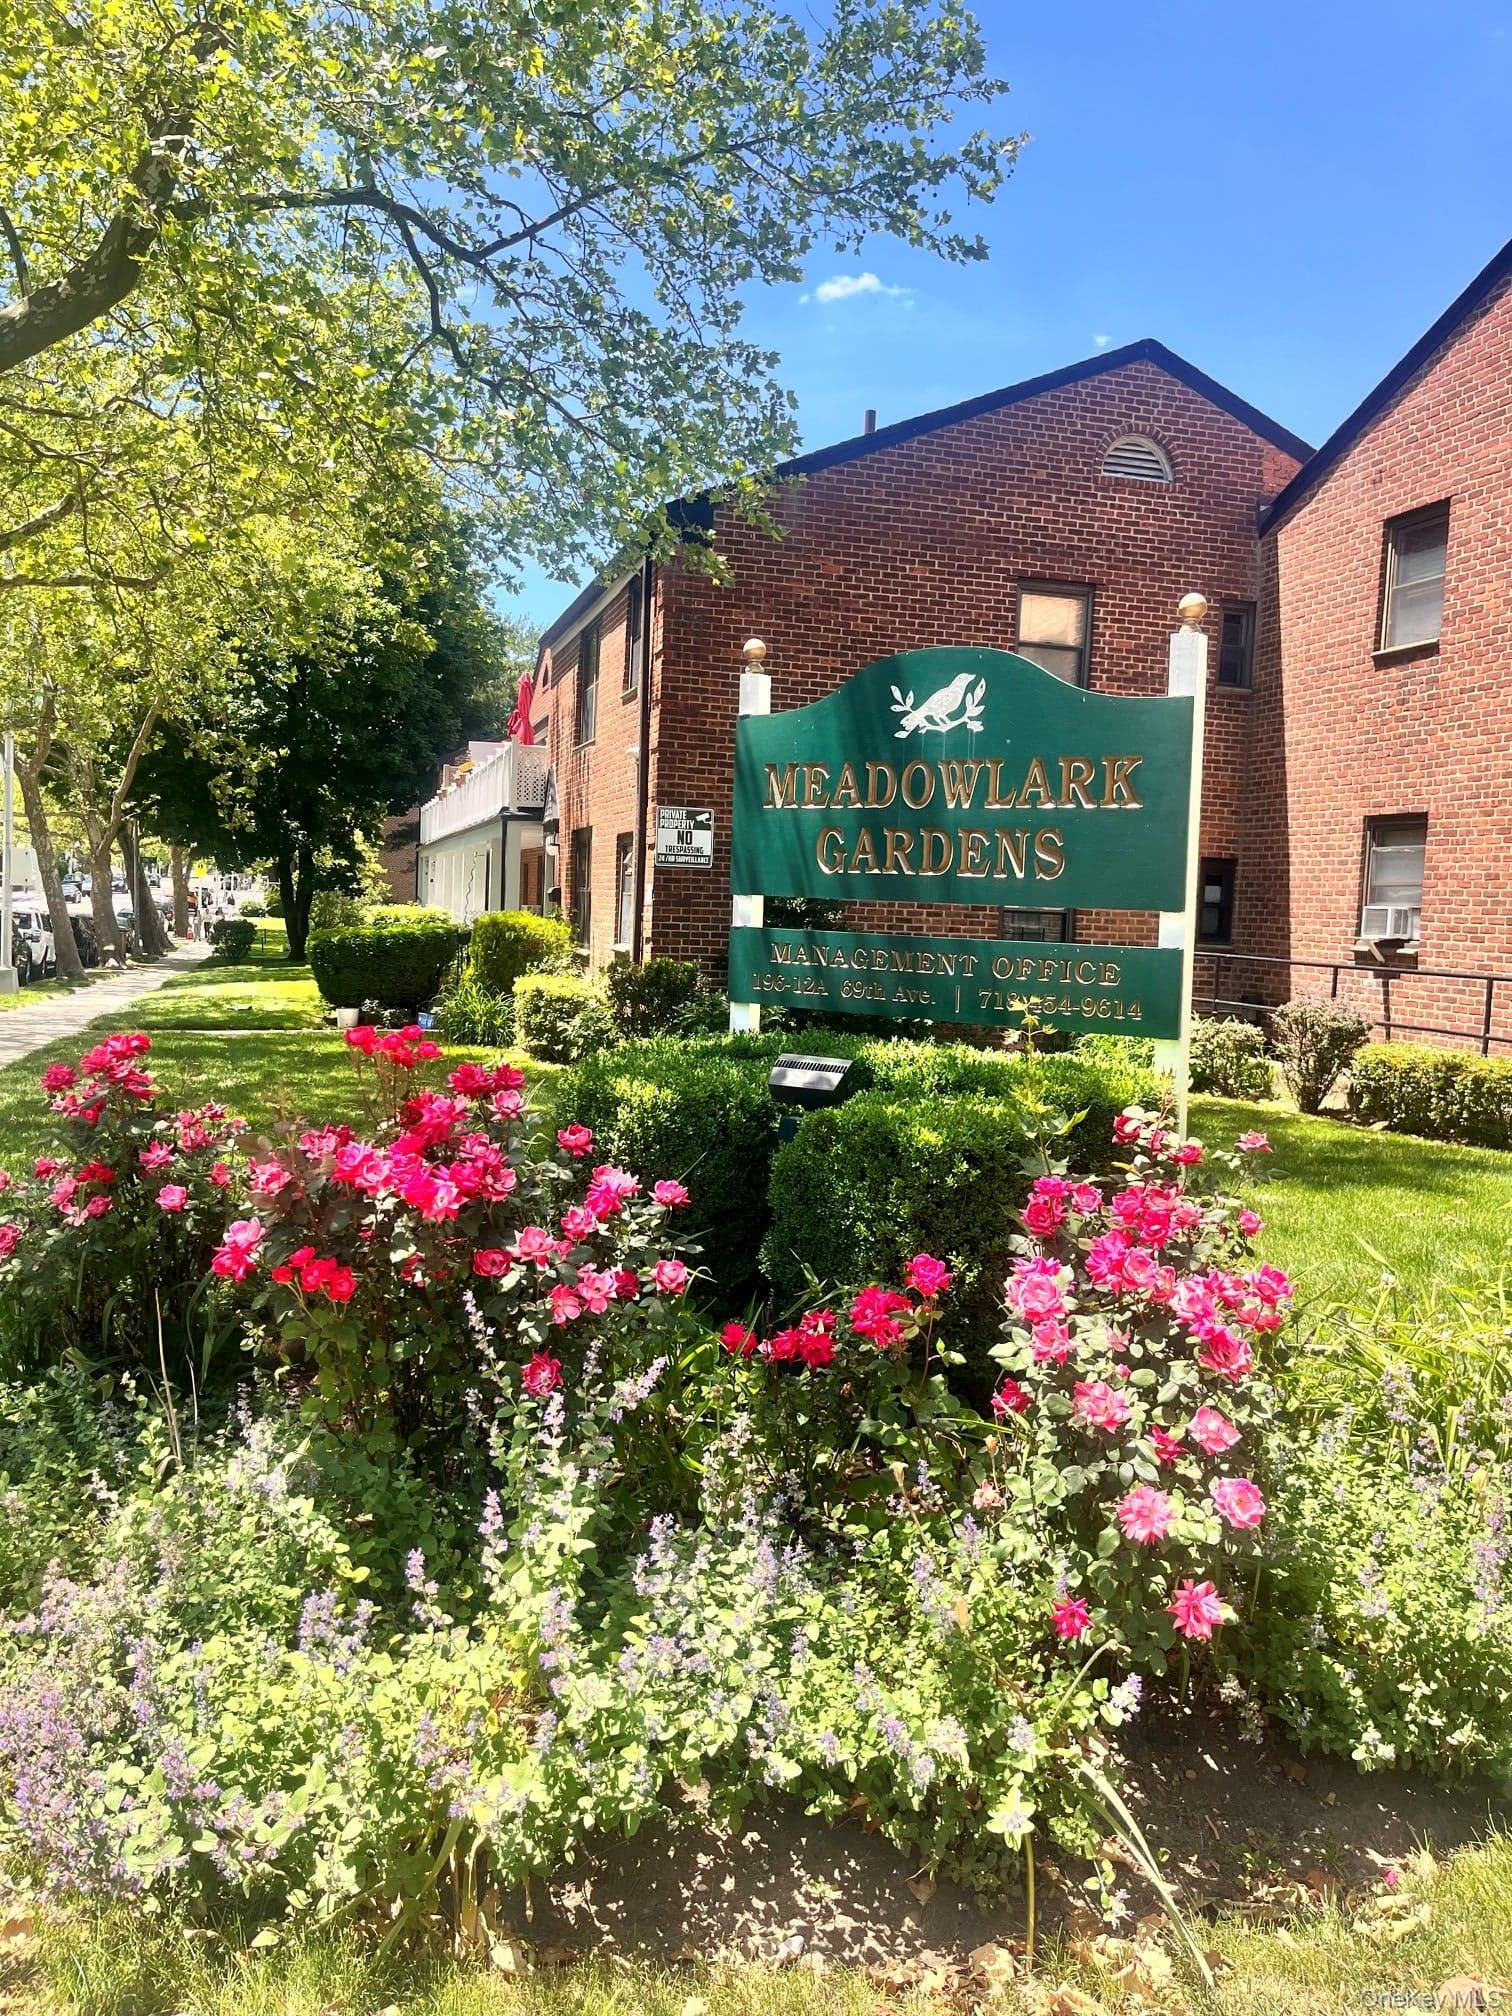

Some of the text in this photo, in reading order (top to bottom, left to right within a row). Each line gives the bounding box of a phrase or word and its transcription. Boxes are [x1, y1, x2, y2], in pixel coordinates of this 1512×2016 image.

[763, 755, 1143, 809] MEADOWLARK
[660, 809, 687, 819] PRIVATE
[660, 819, 695, 829] PROPERTY
[677, 830, 693, 845] NO
[665, 845, 704, 854] TRESPASSING
[815, 826, 1066, 880] GARDENS
[770, 943, 1122, 986] MANAGEMENT OFFICE
[753, 973, 829, 996] 196-12A
[840, 980, 887, 1000] 69th
[892, 986, 936, 1004] Ave.
